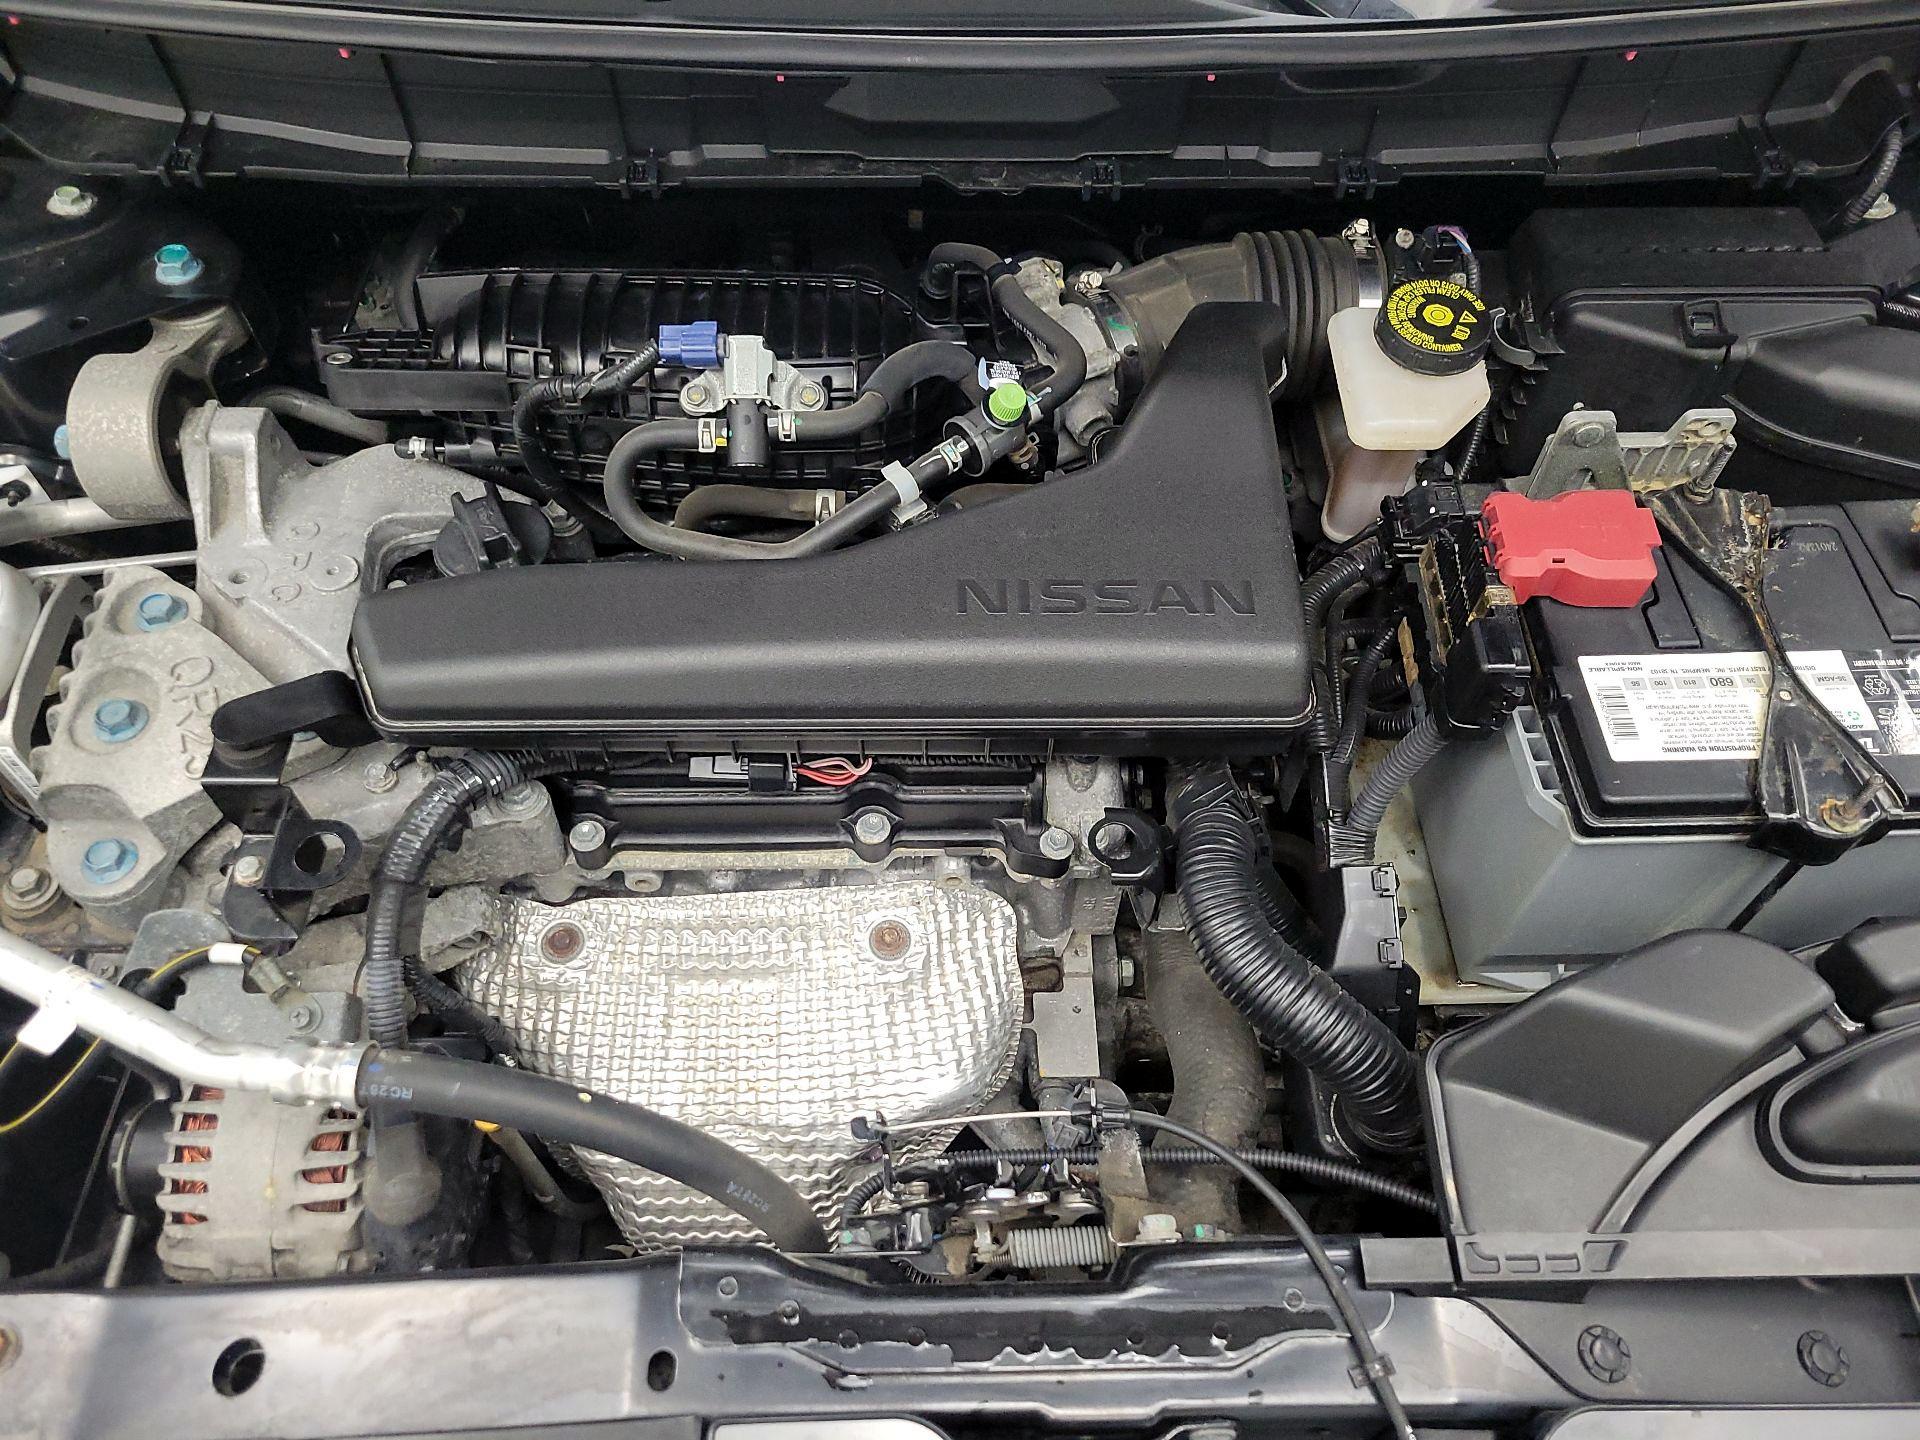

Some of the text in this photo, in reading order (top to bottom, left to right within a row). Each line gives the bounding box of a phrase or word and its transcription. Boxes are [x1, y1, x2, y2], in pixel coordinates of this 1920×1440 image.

[1429, 279, 1441, 287] OR
[1441, 281, 1460, 292] DOT3
[1413, 286, 1436, 296] FILLER
[1436, 286, 1460, 300] CLEAN
[1459, 288, 1477, 302] ONLY
[1397, 327, 1423, 346] SEALED
[1401, 320, 1435, 343] REMOVING
[1422, 341, 1464, 352] CONTAINER
[955, 577, 1257, 617] NISSAN
[1709, 677, 1734, 687] 680
